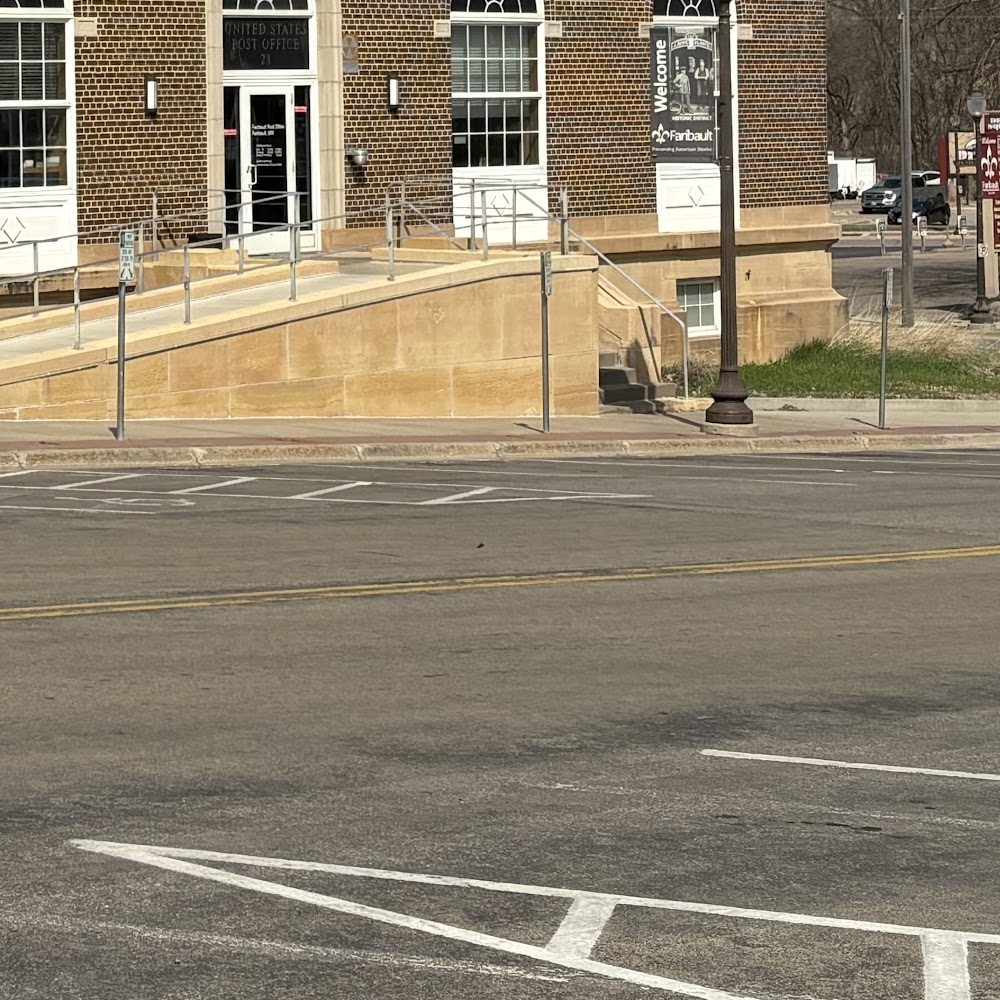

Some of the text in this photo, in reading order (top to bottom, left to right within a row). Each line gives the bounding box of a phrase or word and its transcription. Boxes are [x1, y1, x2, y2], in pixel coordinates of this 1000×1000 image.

[225, 22, 307, 36] UNITED STATES
[232, 38, 300, 50] POST OFFICE
[653, 39, 668, 113] Welcome
[670, 129, 713, 141] Faribault
